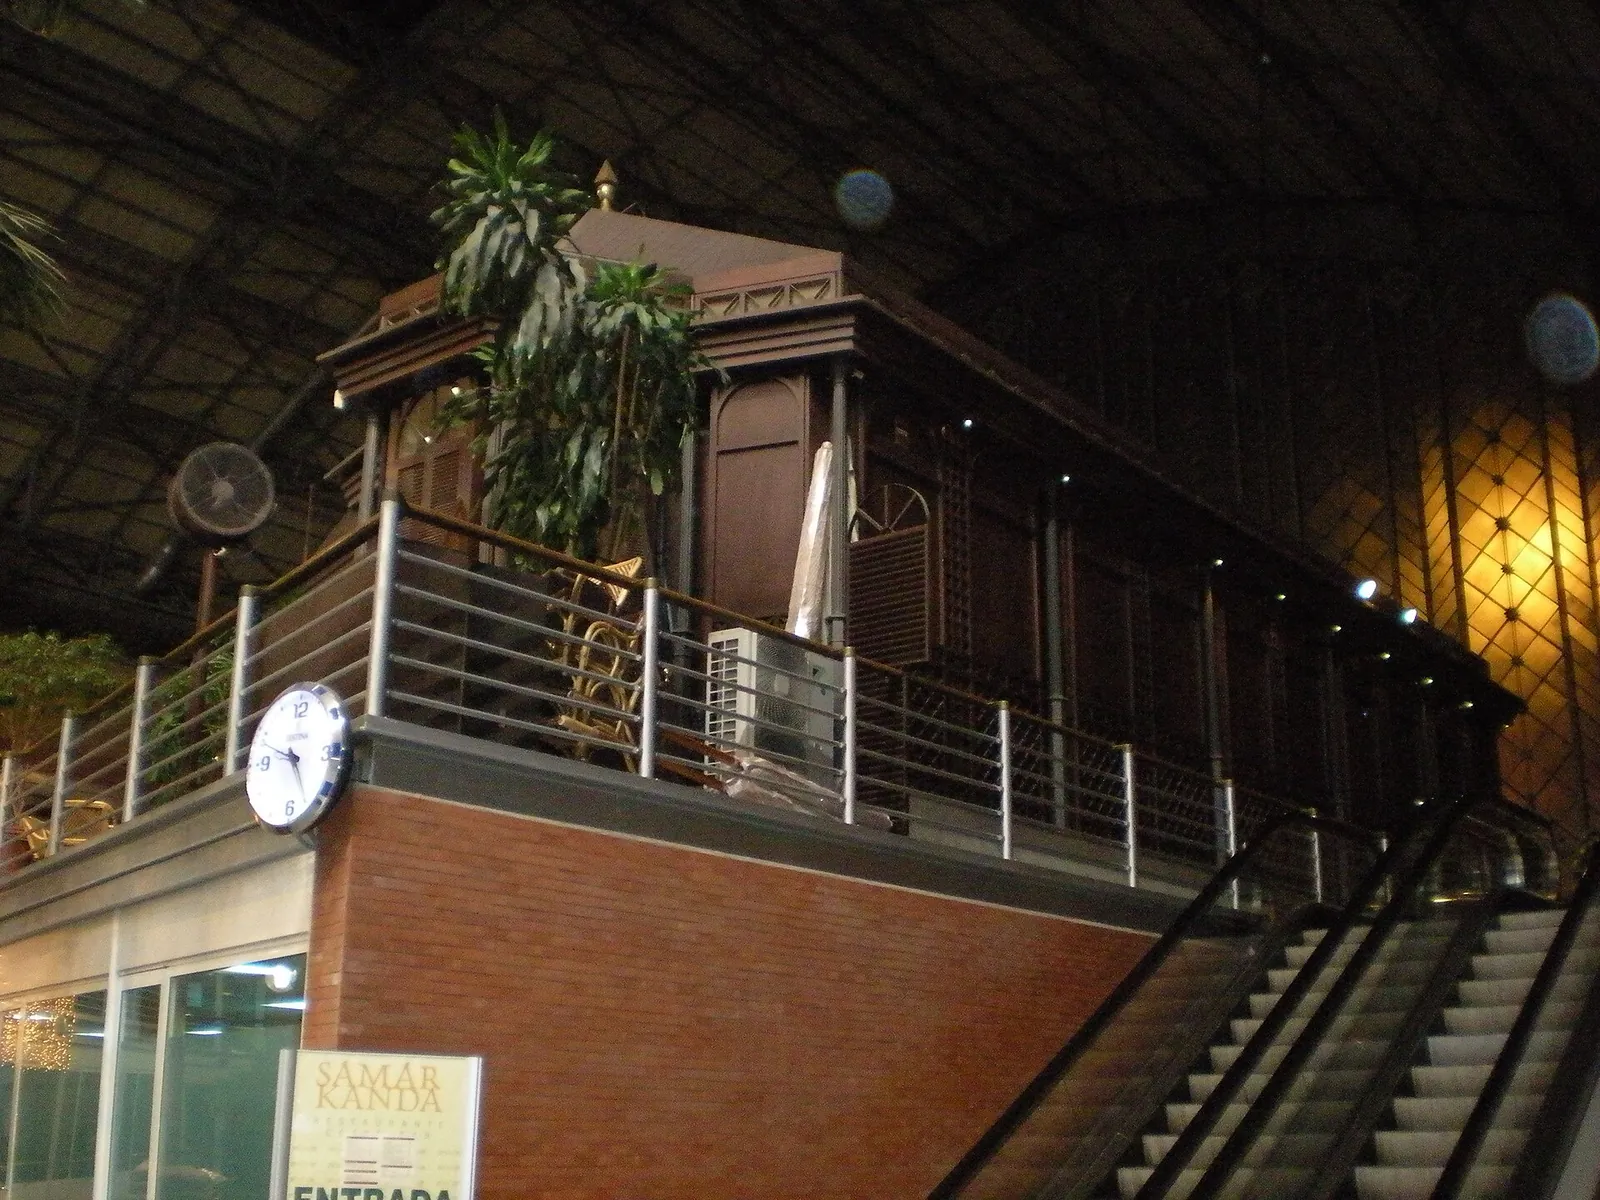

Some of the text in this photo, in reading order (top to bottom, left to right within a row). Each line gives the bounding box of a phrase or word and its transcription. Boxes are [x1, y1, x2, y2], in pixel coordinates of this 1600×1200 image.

[294, 701, 309, 719] 12
[320, 745, 331, 762] 3
[260, 756, 271, 772] 9
[285, 800, 295, 816] 6
[315, 1060, 441, 1090] SAMAR
[315, 1084, 443, 1113] KANDA
